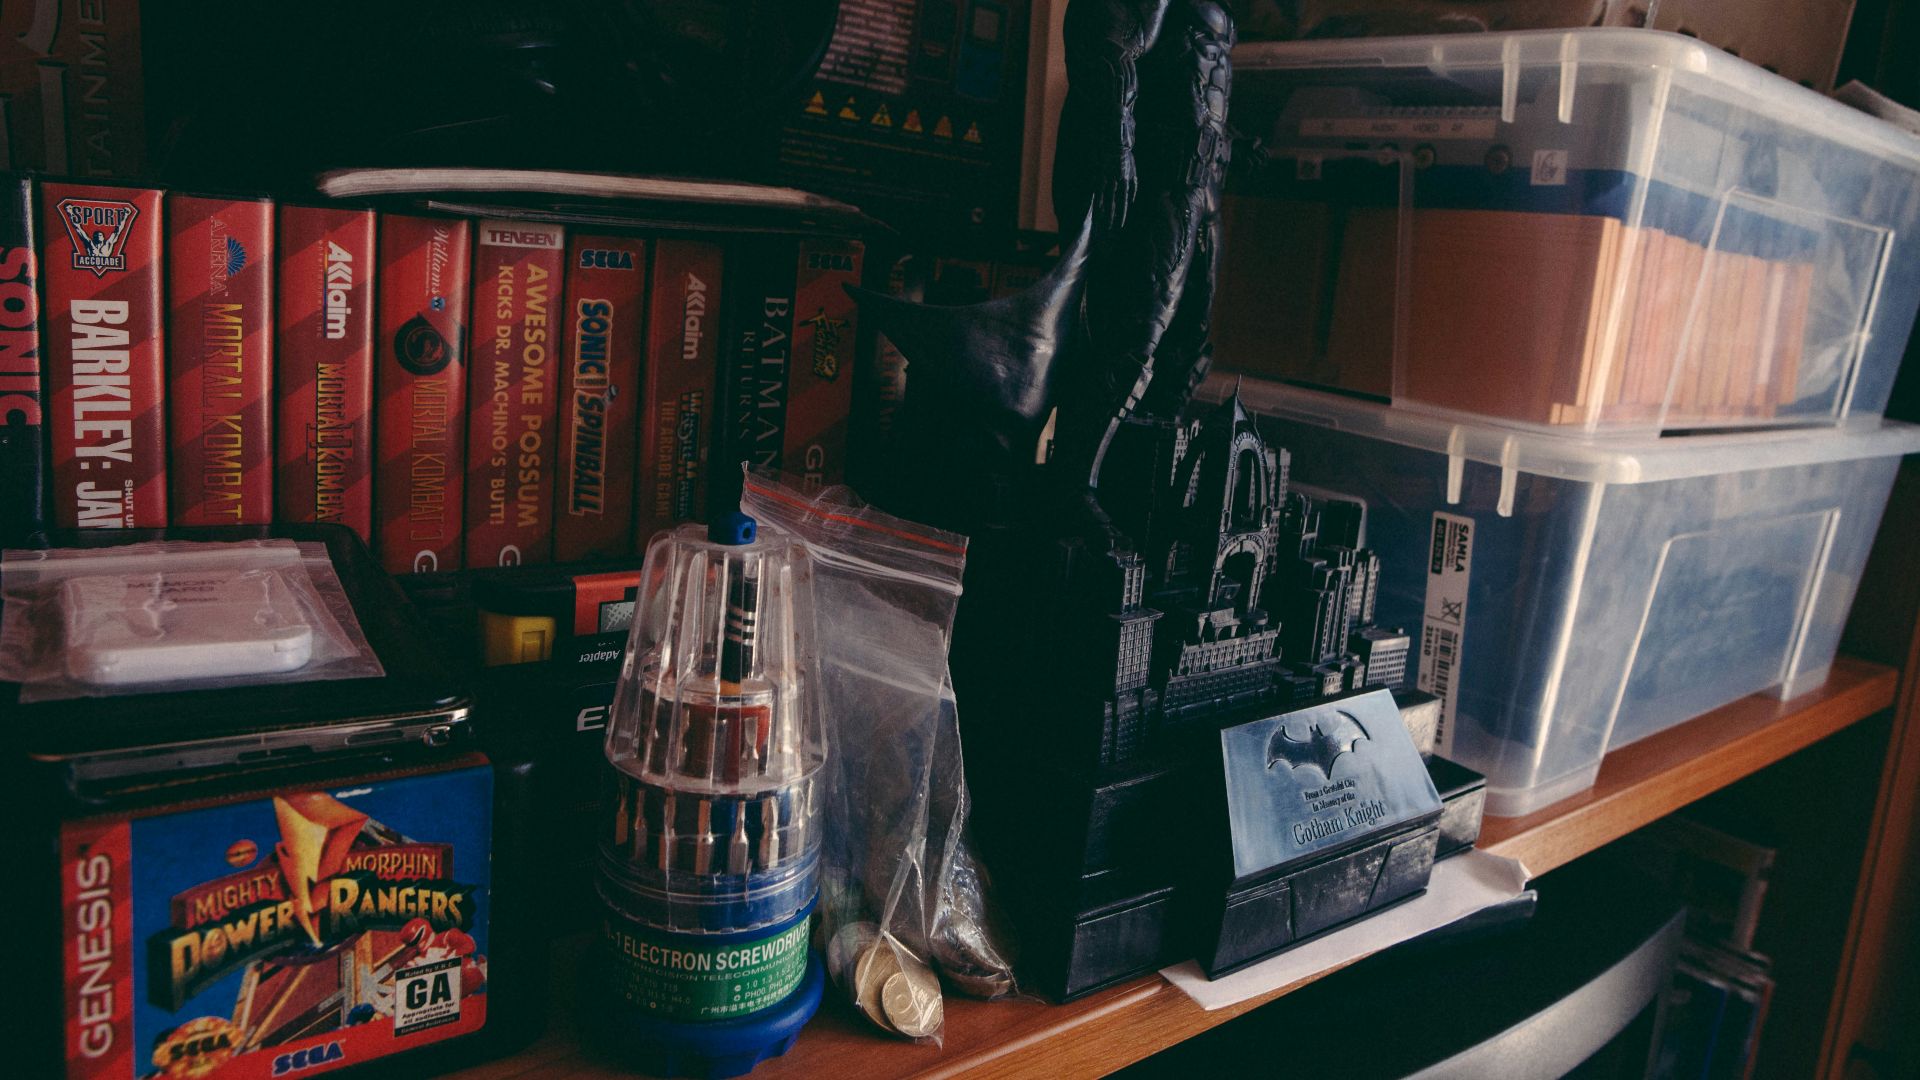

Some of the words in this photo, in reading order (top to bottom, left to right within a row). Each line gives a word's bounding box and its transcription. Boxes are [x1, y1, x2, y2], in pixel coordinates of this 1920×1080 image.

[71, 206, 125, 227] SPORT
[488, 230, 557, 246] TENGEN
[79, 256, 120, 267] ACCOLADE
[210, 217, 228, 297] ARENA
[431, 225, 450, 296] Williams
[580, 249, 634, 271] SEGA
[496, 265, 514, 320] KICKS
[0, 246, 41, 426] SONIC
[203, 303, 243, 413] MORTAL
[495, 326, 512, 355] DR.
[521, 263, 549, 405] AWESOME
[577, 300, 612, 376] SONIC
[71, 299, 133, 470] BARKLEY:
[316, 362, 346, 444] MORTAL
[755, 296, 789, 478] BATMAN
[413, 377, 448, 449] MORTAL
[491, 361, 510, 468] MACHINO'S
[660, 400, 677, 425] THE
[203, 415, 243, 519] KOMBAT
[517, 414, 543, 529] POSSUM
[571, 392, 606, 515] SPINBALL
[657, 428, 675, 479] ARCADE
[124, 479, 134, 511] SHUT
[316, 447, 345, 522] KOMBA
[410, 453, 447, 525] KOMBAT
[489, 478, 506, 526] BUTT!
[655, 482, 672, 519] GAME
[1455, 523, 1469, 572] SAMLA
[578, 649, 620, 664] Adapter
[1304, 791, 1319, 801] From
[1323, 781, 1345, 795] Grateful
[1344, 779, 1355, 788] City
[1312, 803, 1319, 812] In
[1319, 798, 1341, 810] Memory
[1346, 792, 1355, 800] the
[1293, 818, 1344, 845] Gotham
[1344, 800, 1386, 828] Knight
[193, 871, 280, 921] MIGHTY
[346, 852, 437, 876] MORPHIN
[77, 854, 114, 1058] GENESIS
[169, 900, 295, 1010] POWER
[329, 877, 464, 930] RANGERS
[623, 936, 711, 972] ELECTRON
[401, 1005, 444, 1019] Appropriate
[445, 1001, 456, 1009] for
[406, 972, 452, 1010] GA
[415, 1009, 451, 1022] audiences
[169, 1033, 231, 1060] SEGA
[272, 1040, 345, 1077] SEGA
